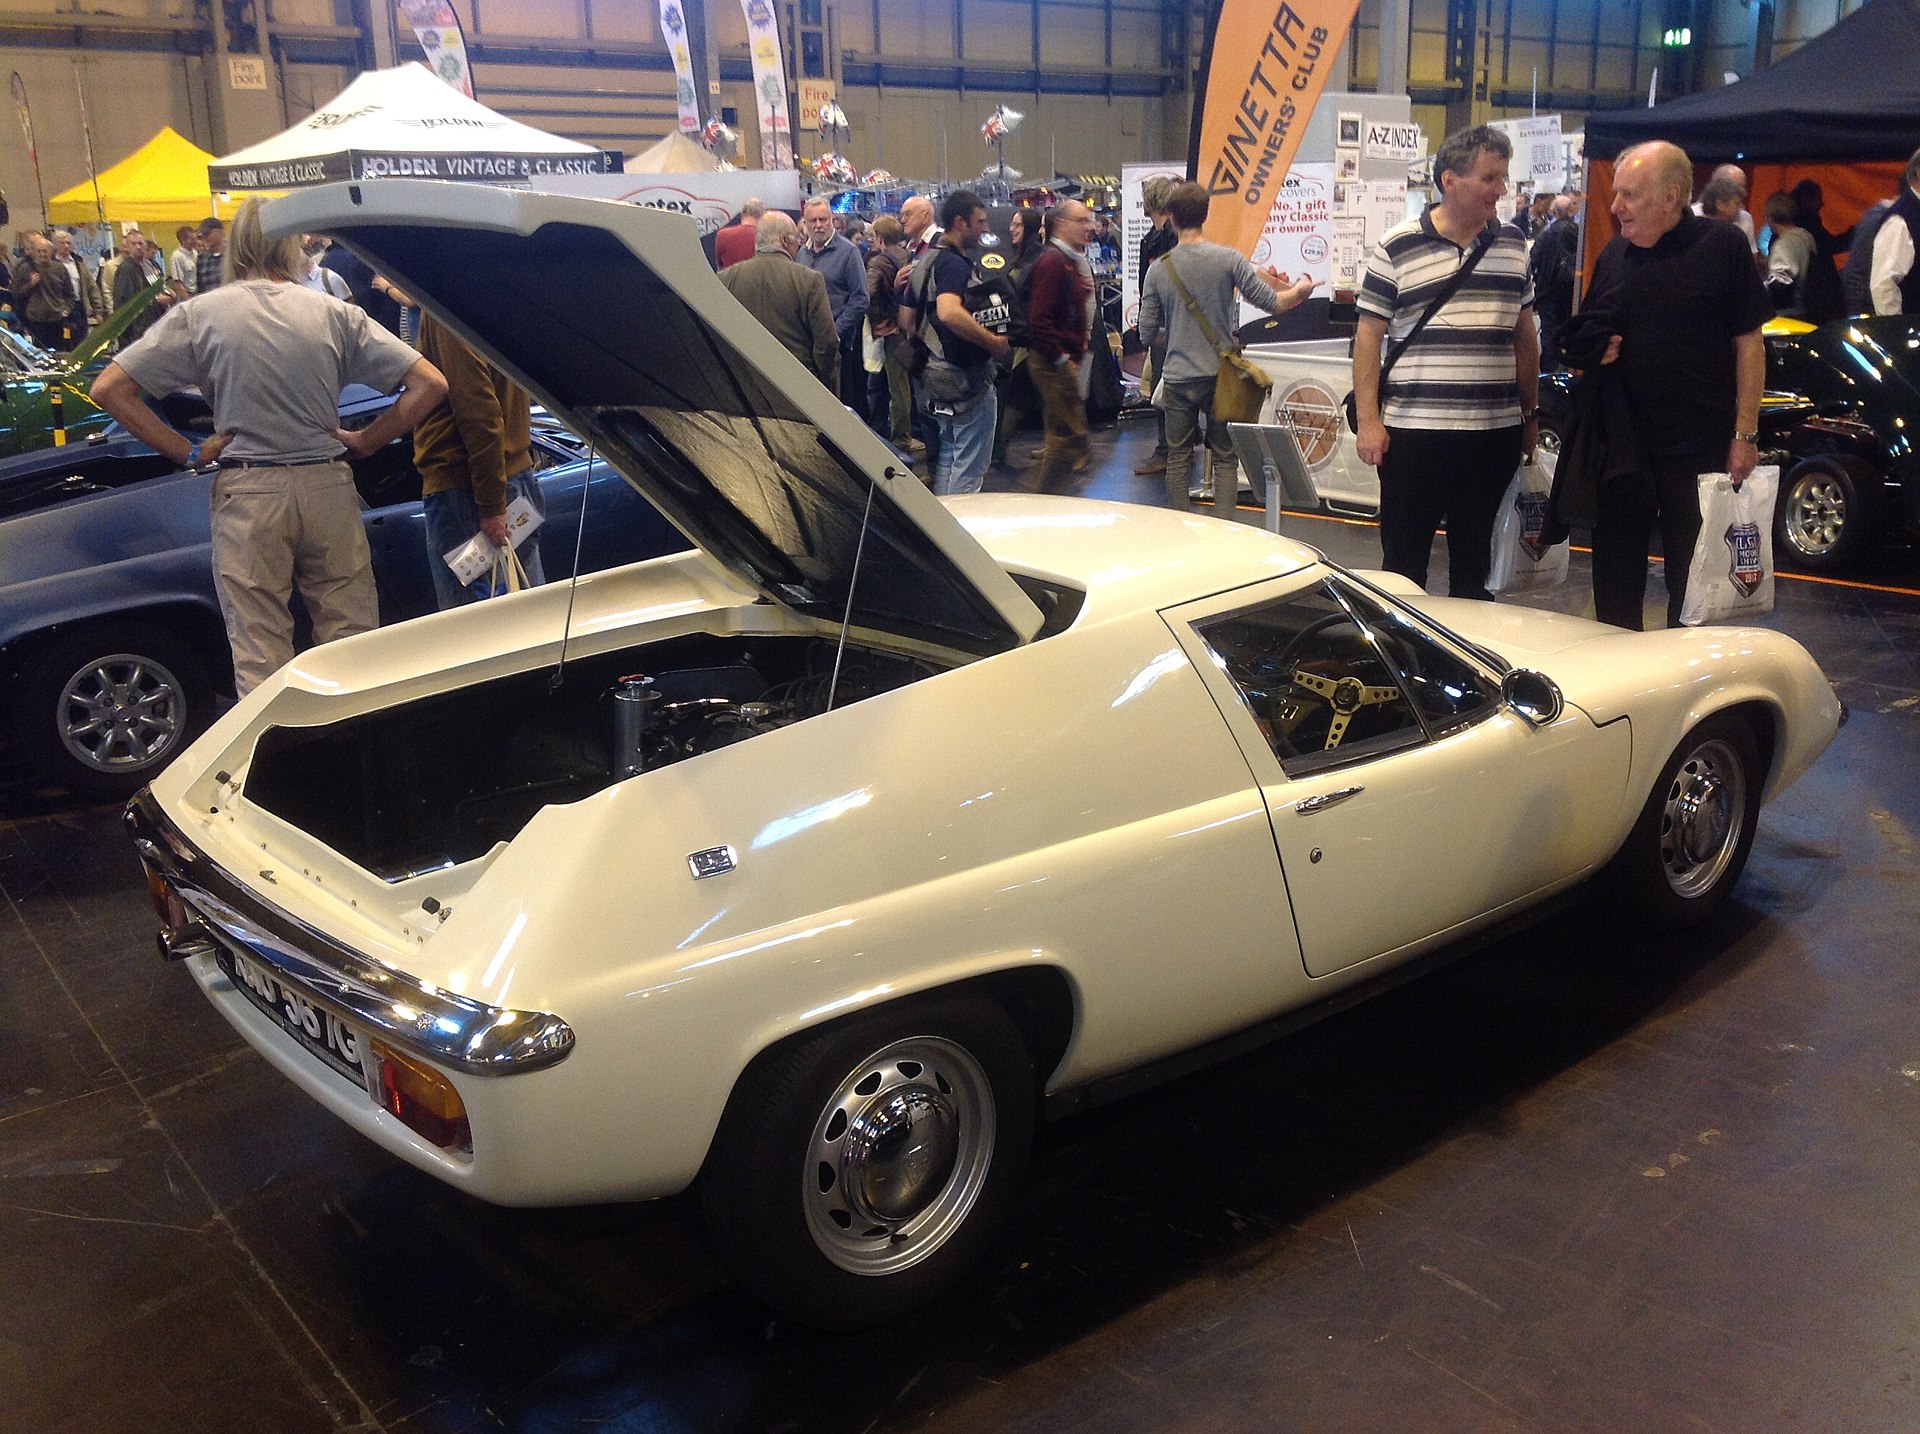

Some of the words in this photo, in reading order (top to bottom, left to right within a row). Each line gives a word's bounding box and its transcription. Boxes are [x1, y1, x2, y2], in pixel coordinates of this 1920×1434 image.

[1291, 27, 1329, 91] CLUB
[804, 87, 829, 101] Fire
[1208, 1, 1305, 196] GINETTA
[421, 117, 485, 129] HOLDEN
[1367, 126, 1391, 145] A-Z
[1391, 127, 1419, 149] INDEX
[229, 170, 259, 187] HOLDEN
[259, 167, 289, 185] VINTAGE
[295, 161, 326, 182] CLASSIC
[362, 157, 438, 176] HOLDEN
[447, 157, 516, 176] VINTAGE
[521, 158, 531, 176] &
[536, 158, 598, 176] CLASSIC
[1280, 188, 1317, 198] covers
[1273, 201, 1293, 211] No.
[1297, 201, 1301, 210] 1
[1305, 200, 1327, 213] gift
[1290, 211, 1329, 222] Classic
[1263, 226, 1277, 234] ar
[1279, 224, 1316, 234] owner
[972, 303, 1010, 322] GERTY
